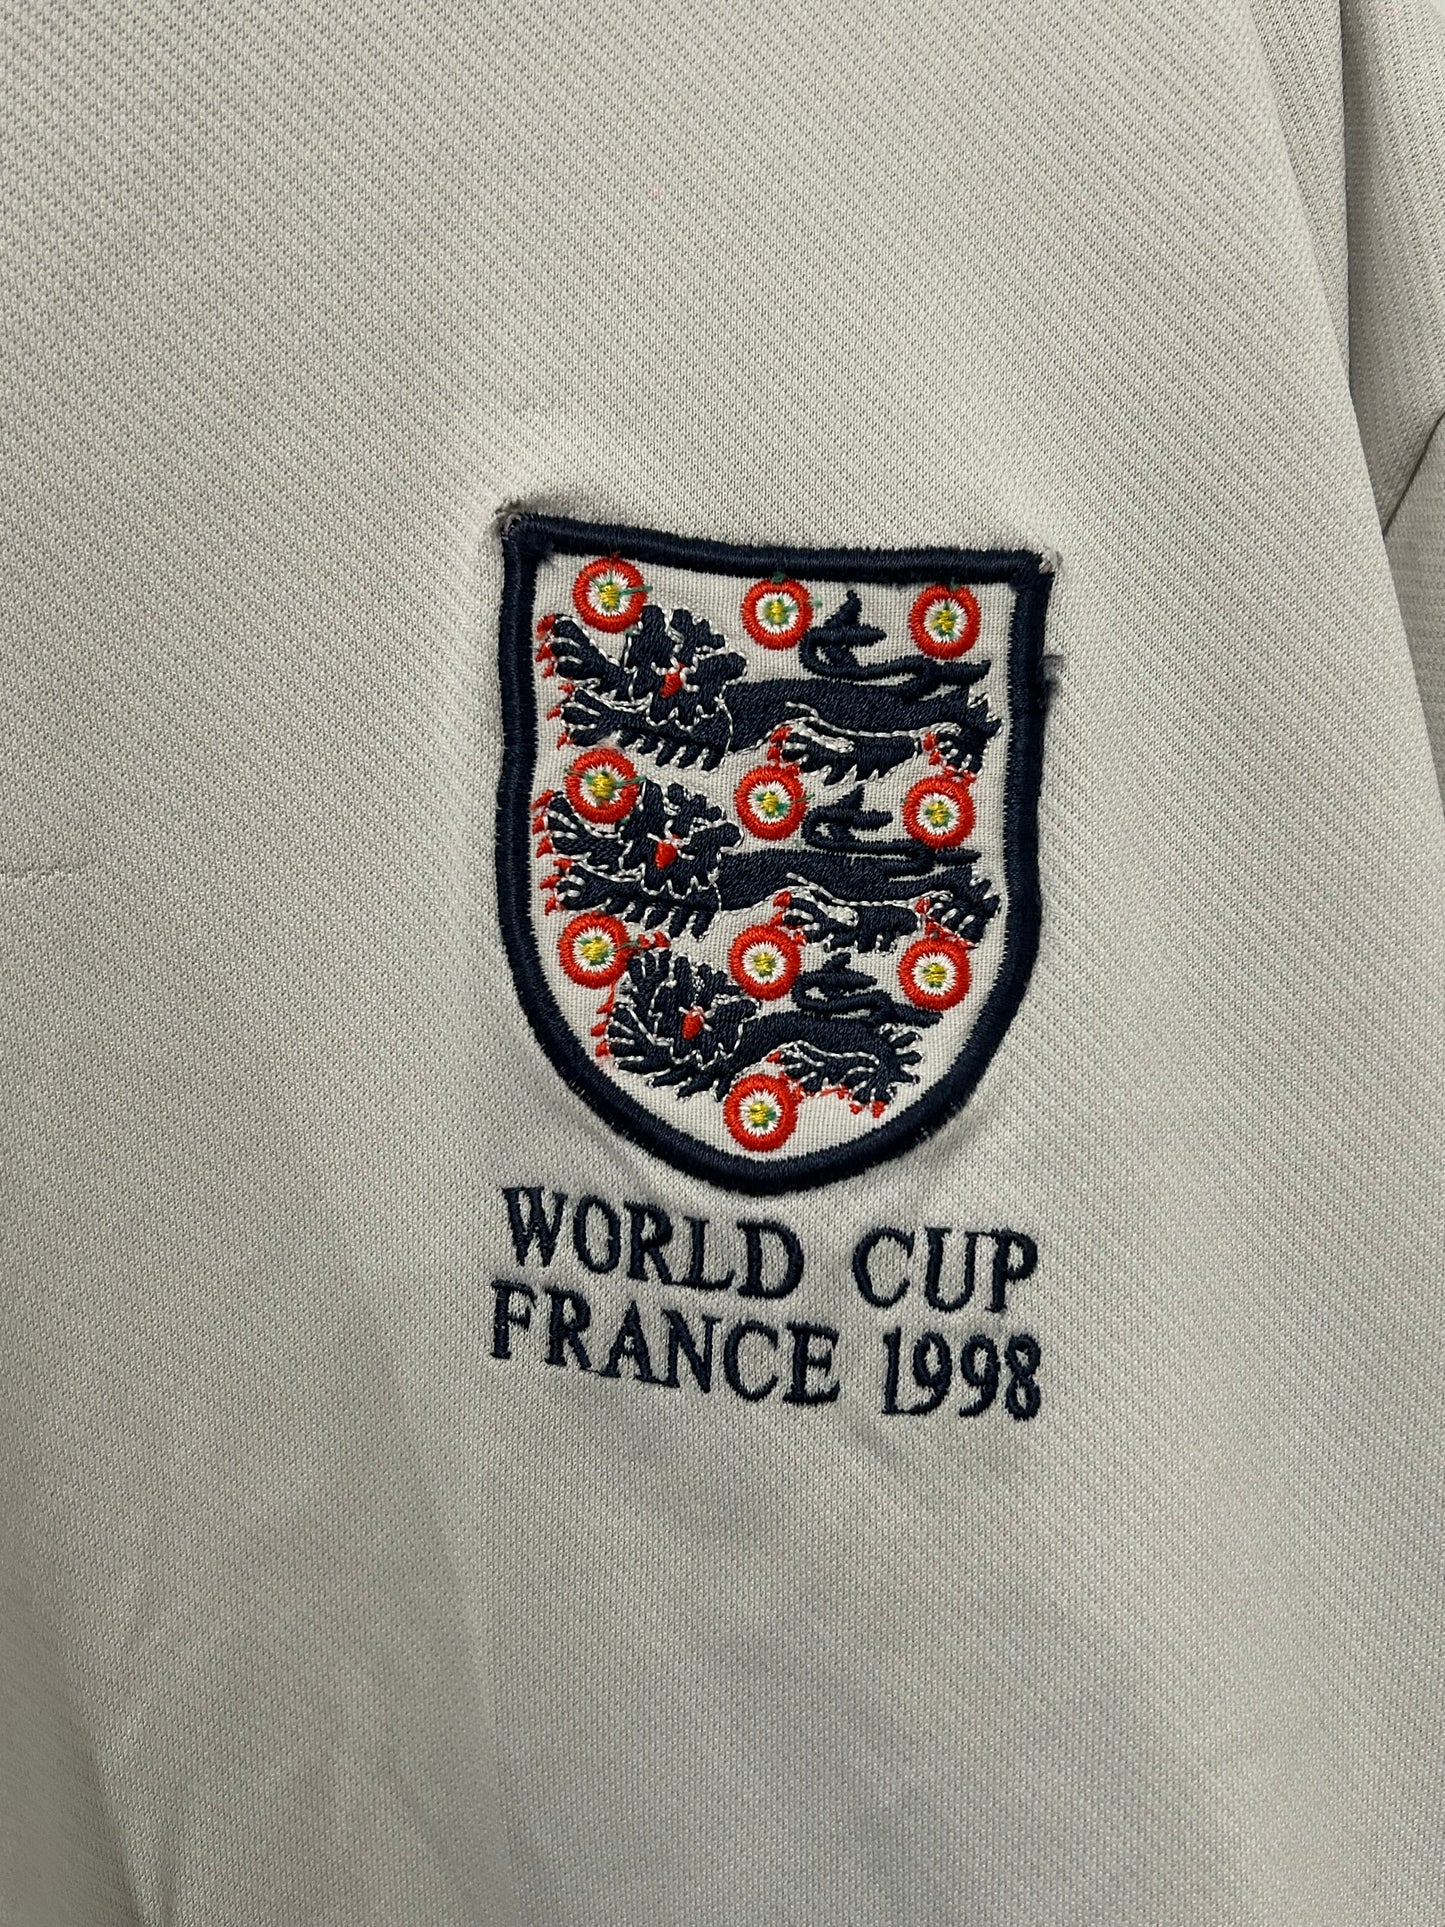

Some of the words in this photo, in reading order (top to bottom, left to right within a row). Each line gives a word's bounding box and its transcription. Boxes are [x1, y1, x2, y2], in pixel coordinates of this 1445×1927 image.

[500, 1184, 805, 1302] WORLD
[851, 1225, 1039, 1317] CUP
[489, 1275, 841, 1408] FRANCE
[880, 1326, 1042, 1422] 1998
